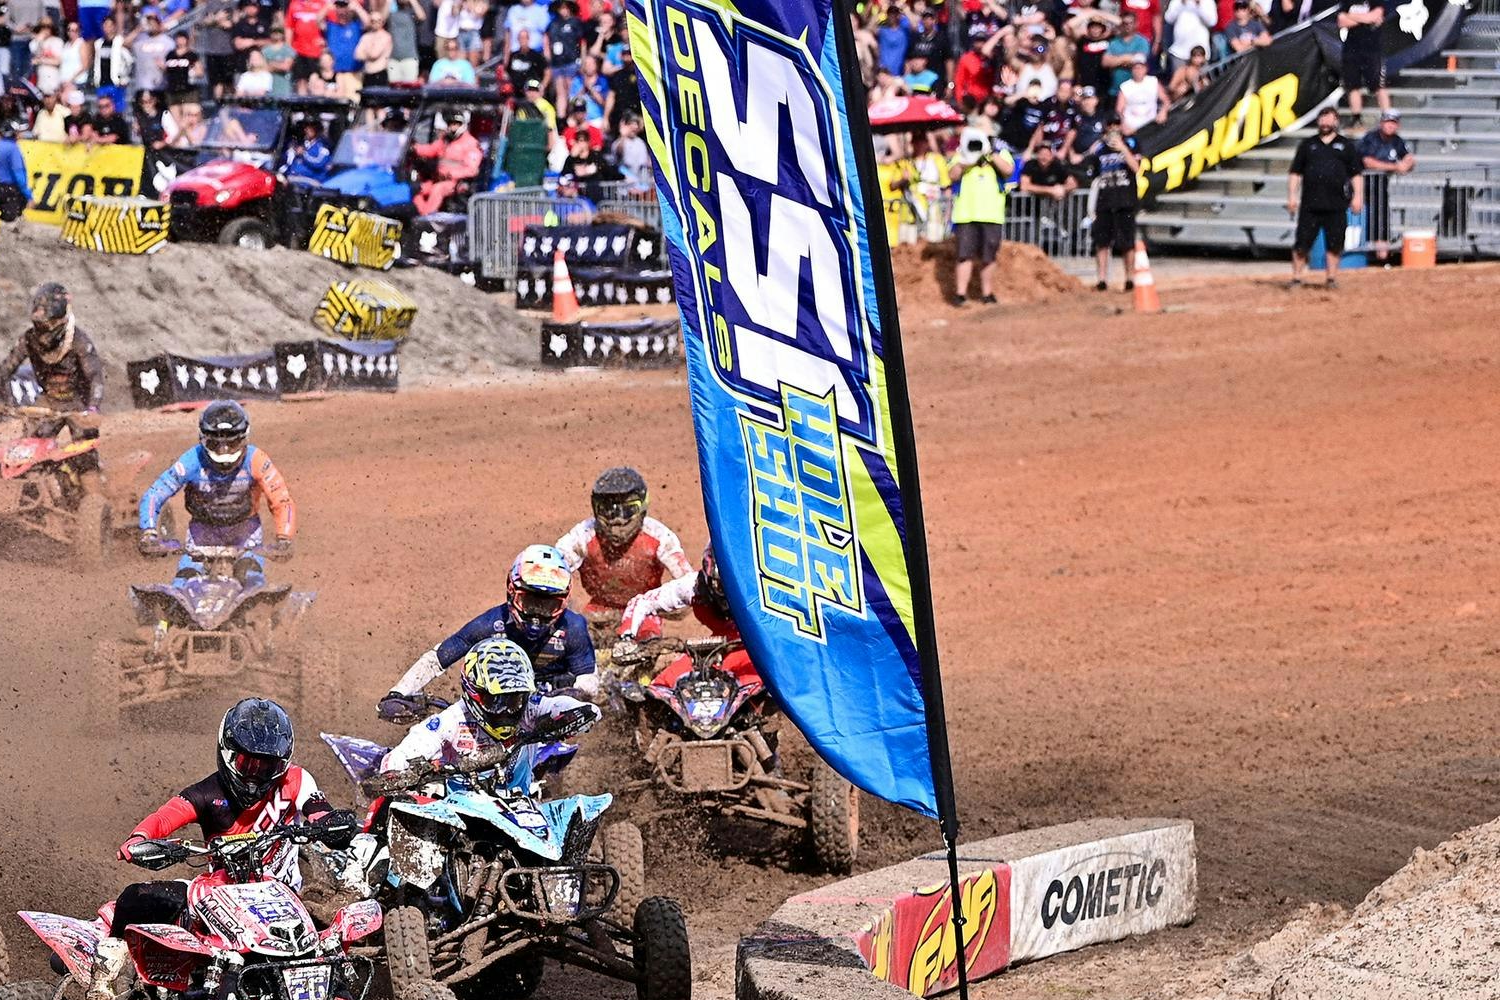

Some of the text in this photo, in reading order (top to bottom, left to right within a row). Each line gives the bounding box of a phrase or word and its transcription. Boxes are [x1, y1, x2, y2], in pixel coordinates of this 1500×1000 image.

[666, 5, 733, 373] DECALS
[1152, 72, 1299, 192] THOR
[1041, 858, 1167, 930] COMETIC
